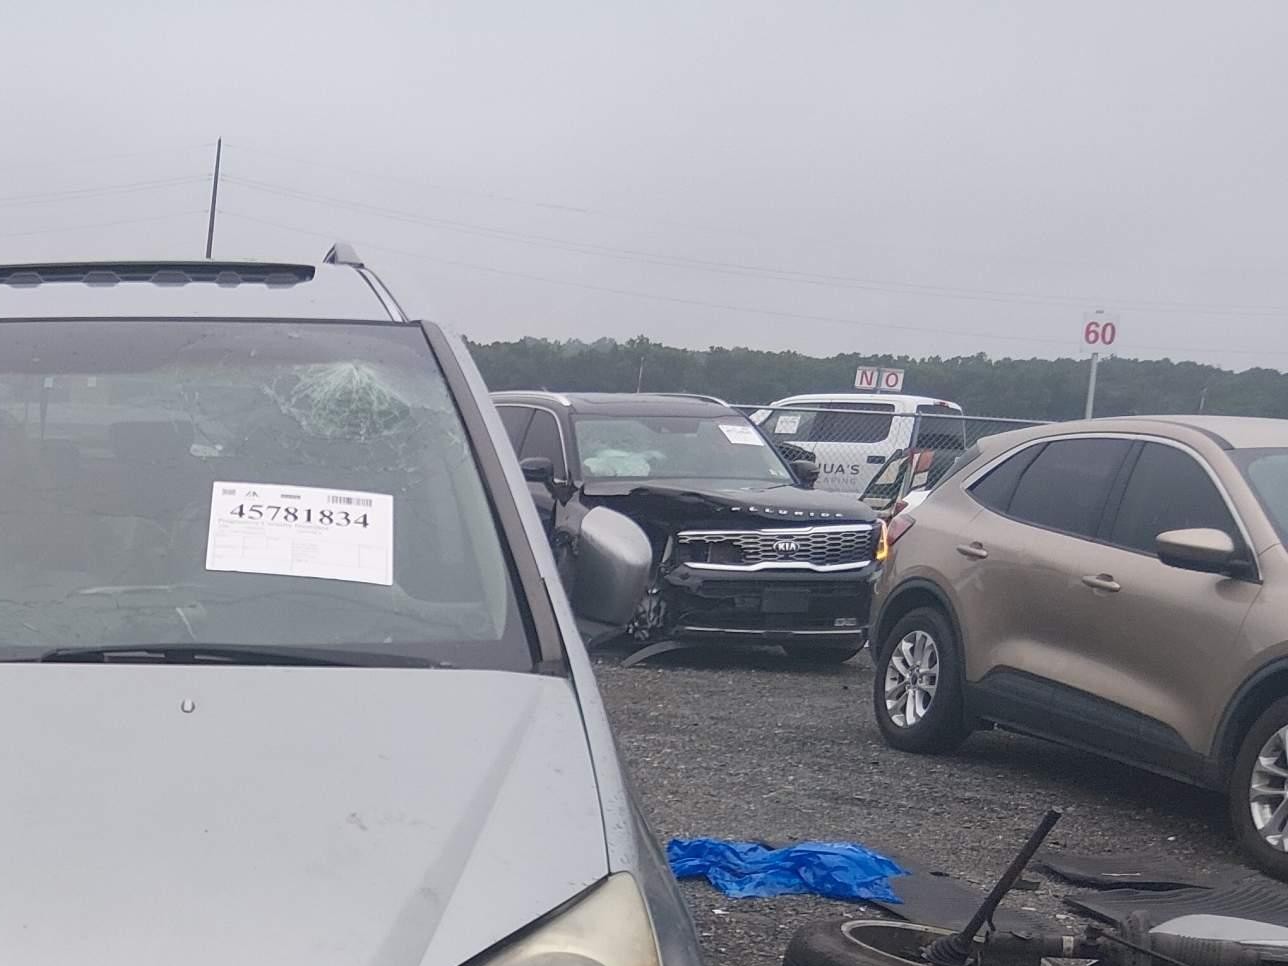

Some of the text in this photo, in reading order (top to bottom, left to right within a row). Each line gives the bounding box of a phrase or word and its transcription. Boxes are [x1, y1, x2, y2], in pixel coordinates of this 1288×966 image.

[1084, 320, 1117, 346] 60
[859, 371, 875, 387] N
[818, 462, 861, 476] UA'S
[229, 503, 371, 529] 45781834
[777, 542, 797, 552] KIA
